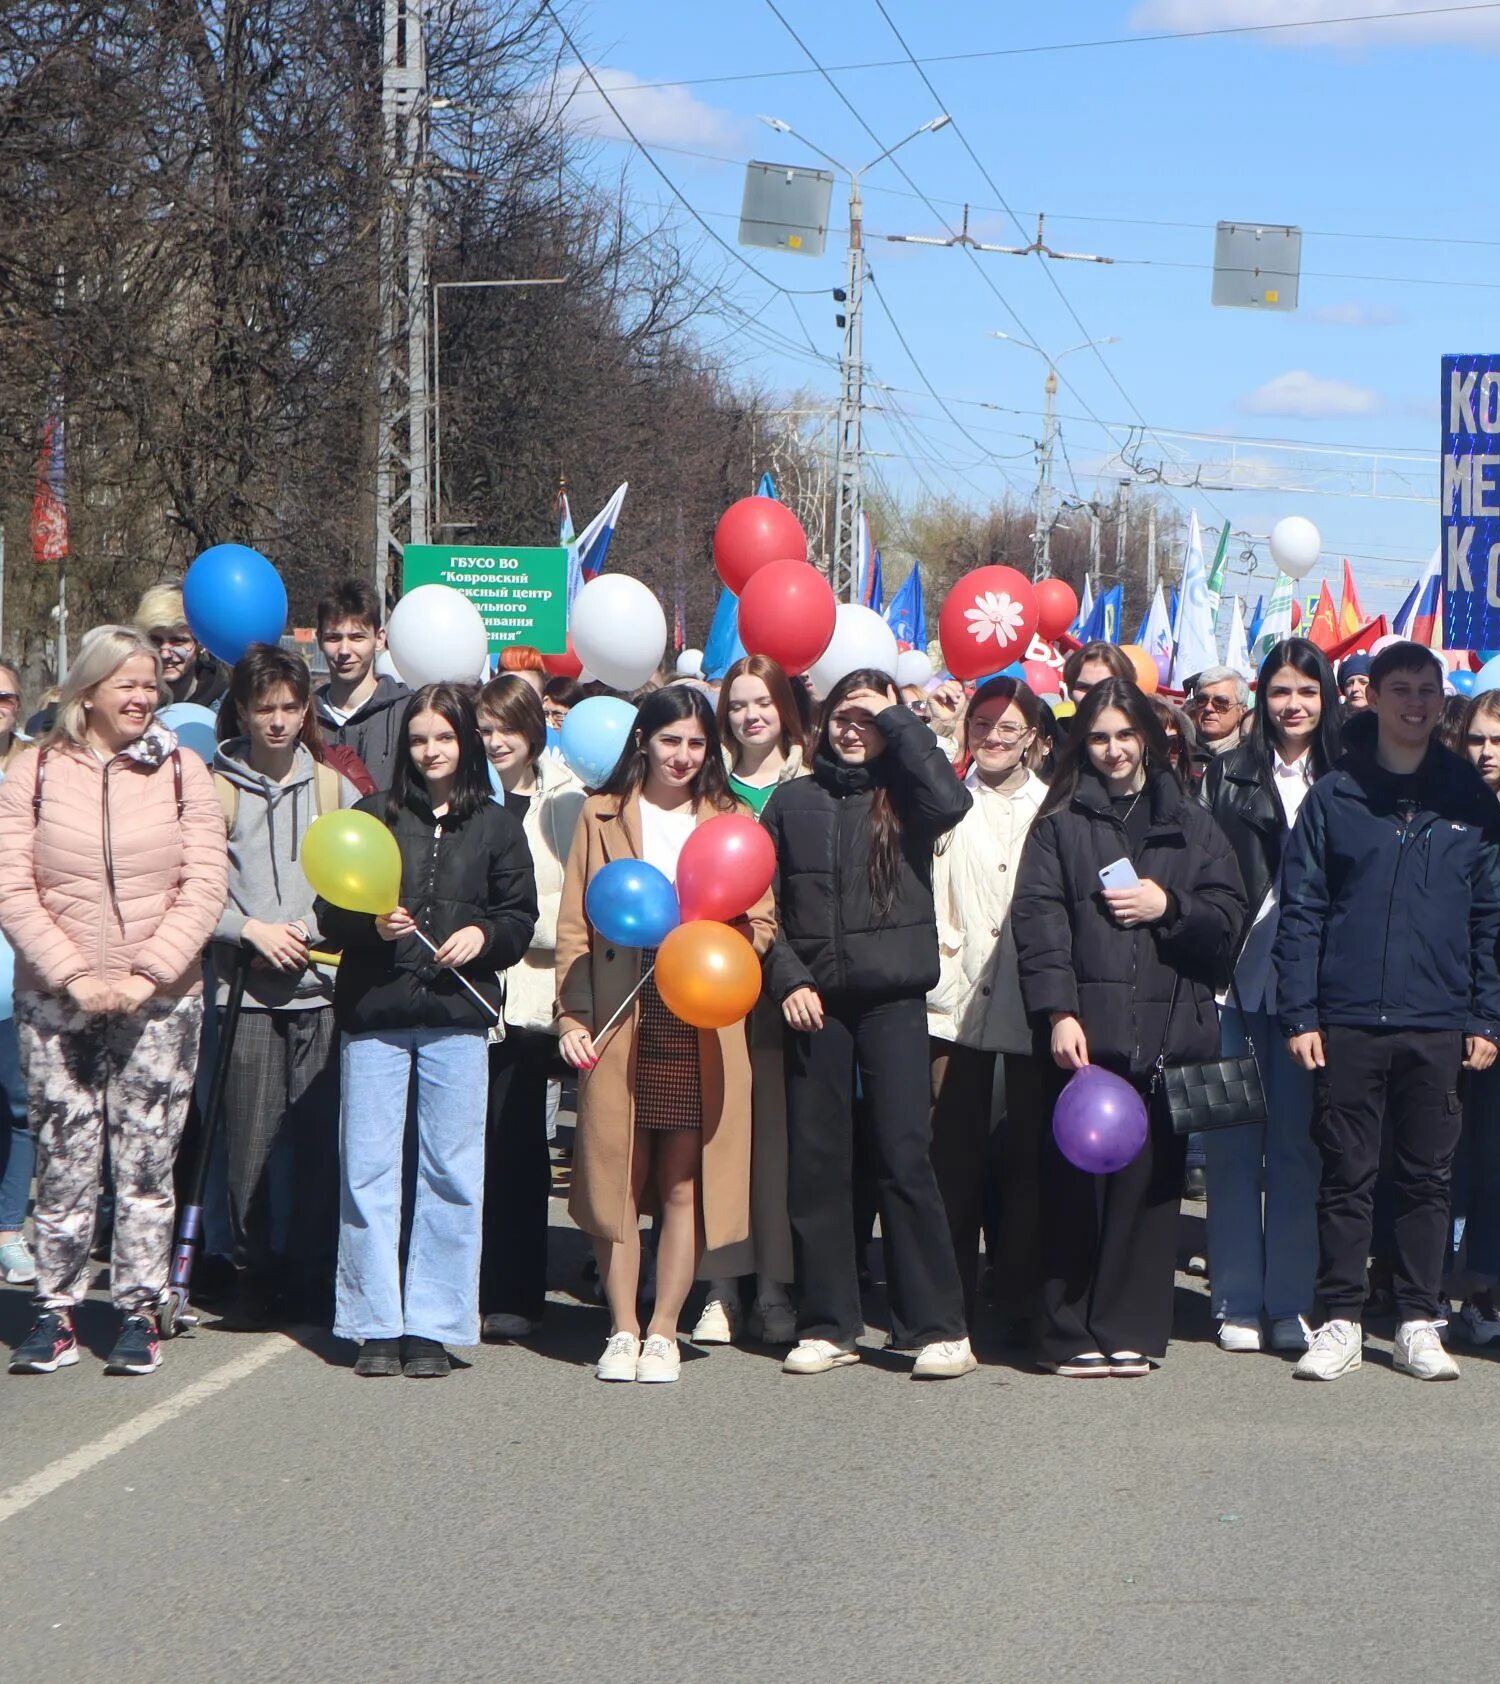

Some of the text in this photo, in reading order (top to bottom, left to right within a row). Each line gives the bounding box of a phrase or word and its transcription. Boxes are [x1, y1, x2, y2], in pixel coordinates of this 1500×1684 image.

[450, 557, 519, 569] ГБУСО ВО
[440, 571, 529, 585] "Ковровский
[457, 587, 552, 601] ексный центр
[474, 602, 527, 612] ального
[482, 617, 534, 627] ивания
